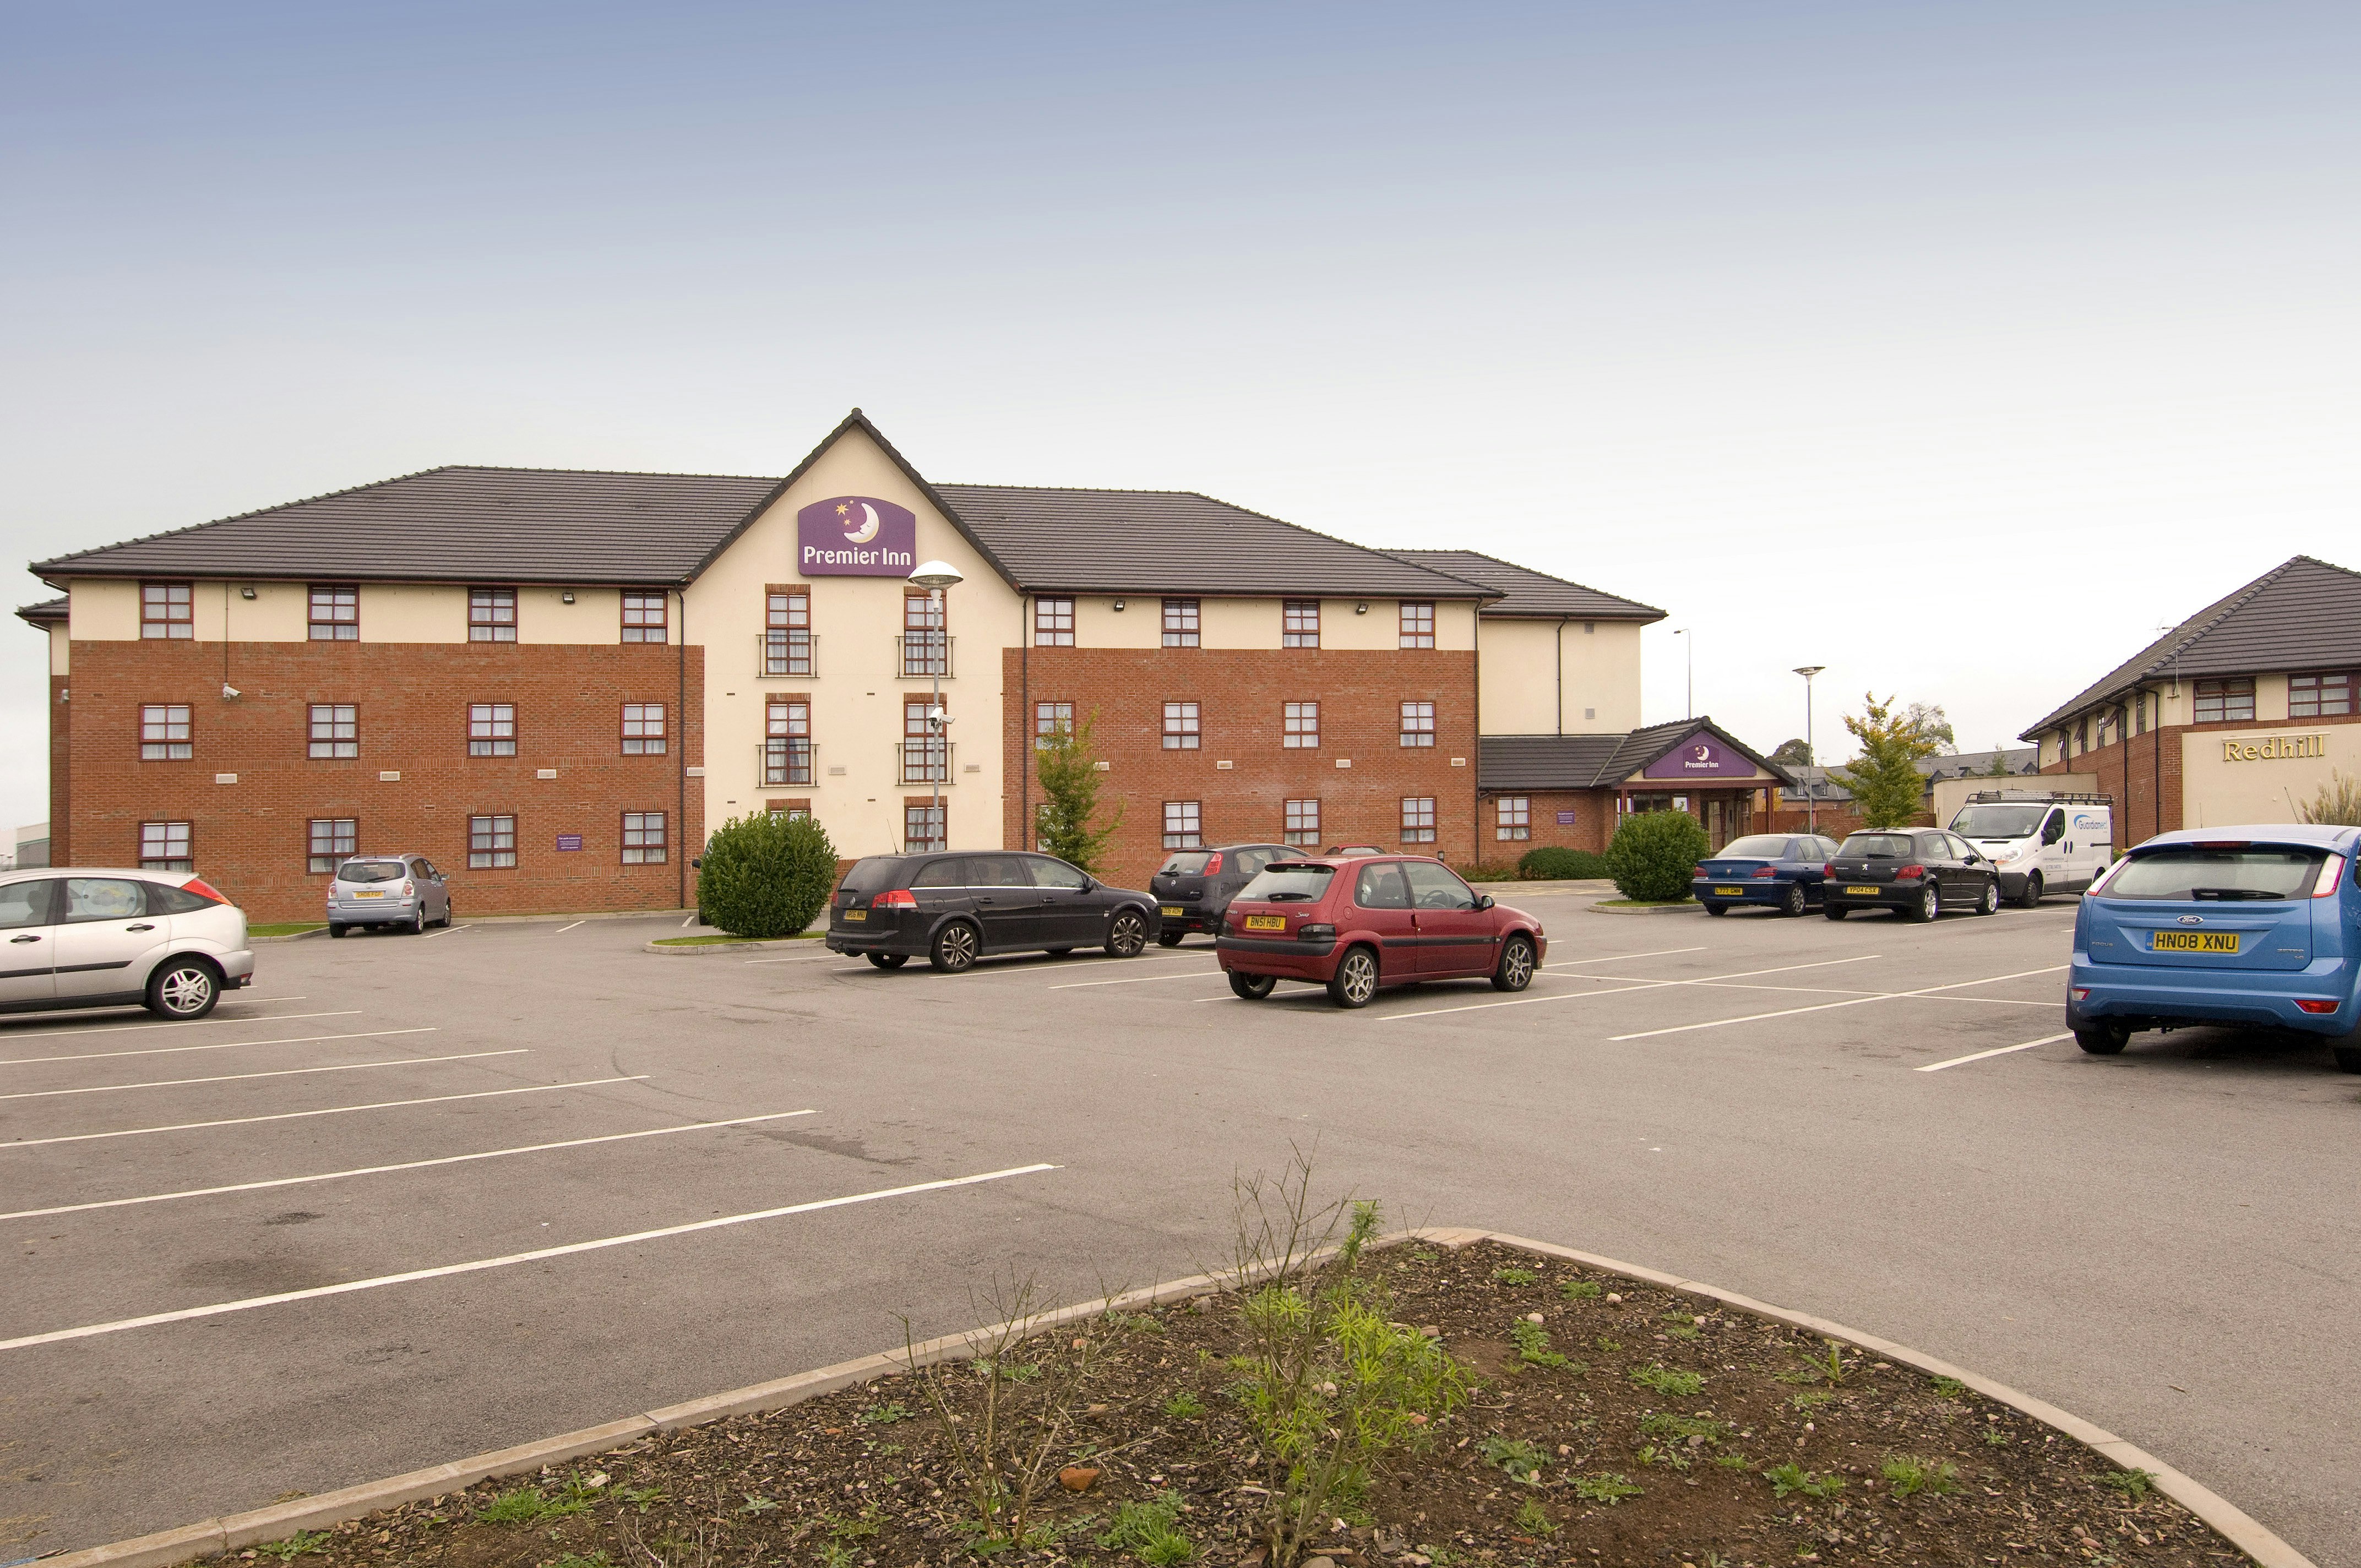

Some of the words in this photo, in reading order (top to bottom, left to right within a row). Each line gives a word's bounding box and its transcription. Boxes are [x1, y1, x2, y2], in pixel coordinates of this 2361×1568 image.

[803, 546, 879, 565] Premier
[883, 547, 911, 565] Inn
[2223, 735, 2325, 762] Redhill
[1250, 917, 1266, 927] BN51
[1266, 918, 1281, 928] HBU
[2156, 933, 2198, 949] HN08
[2203, 934, 2236, 950] XNU
